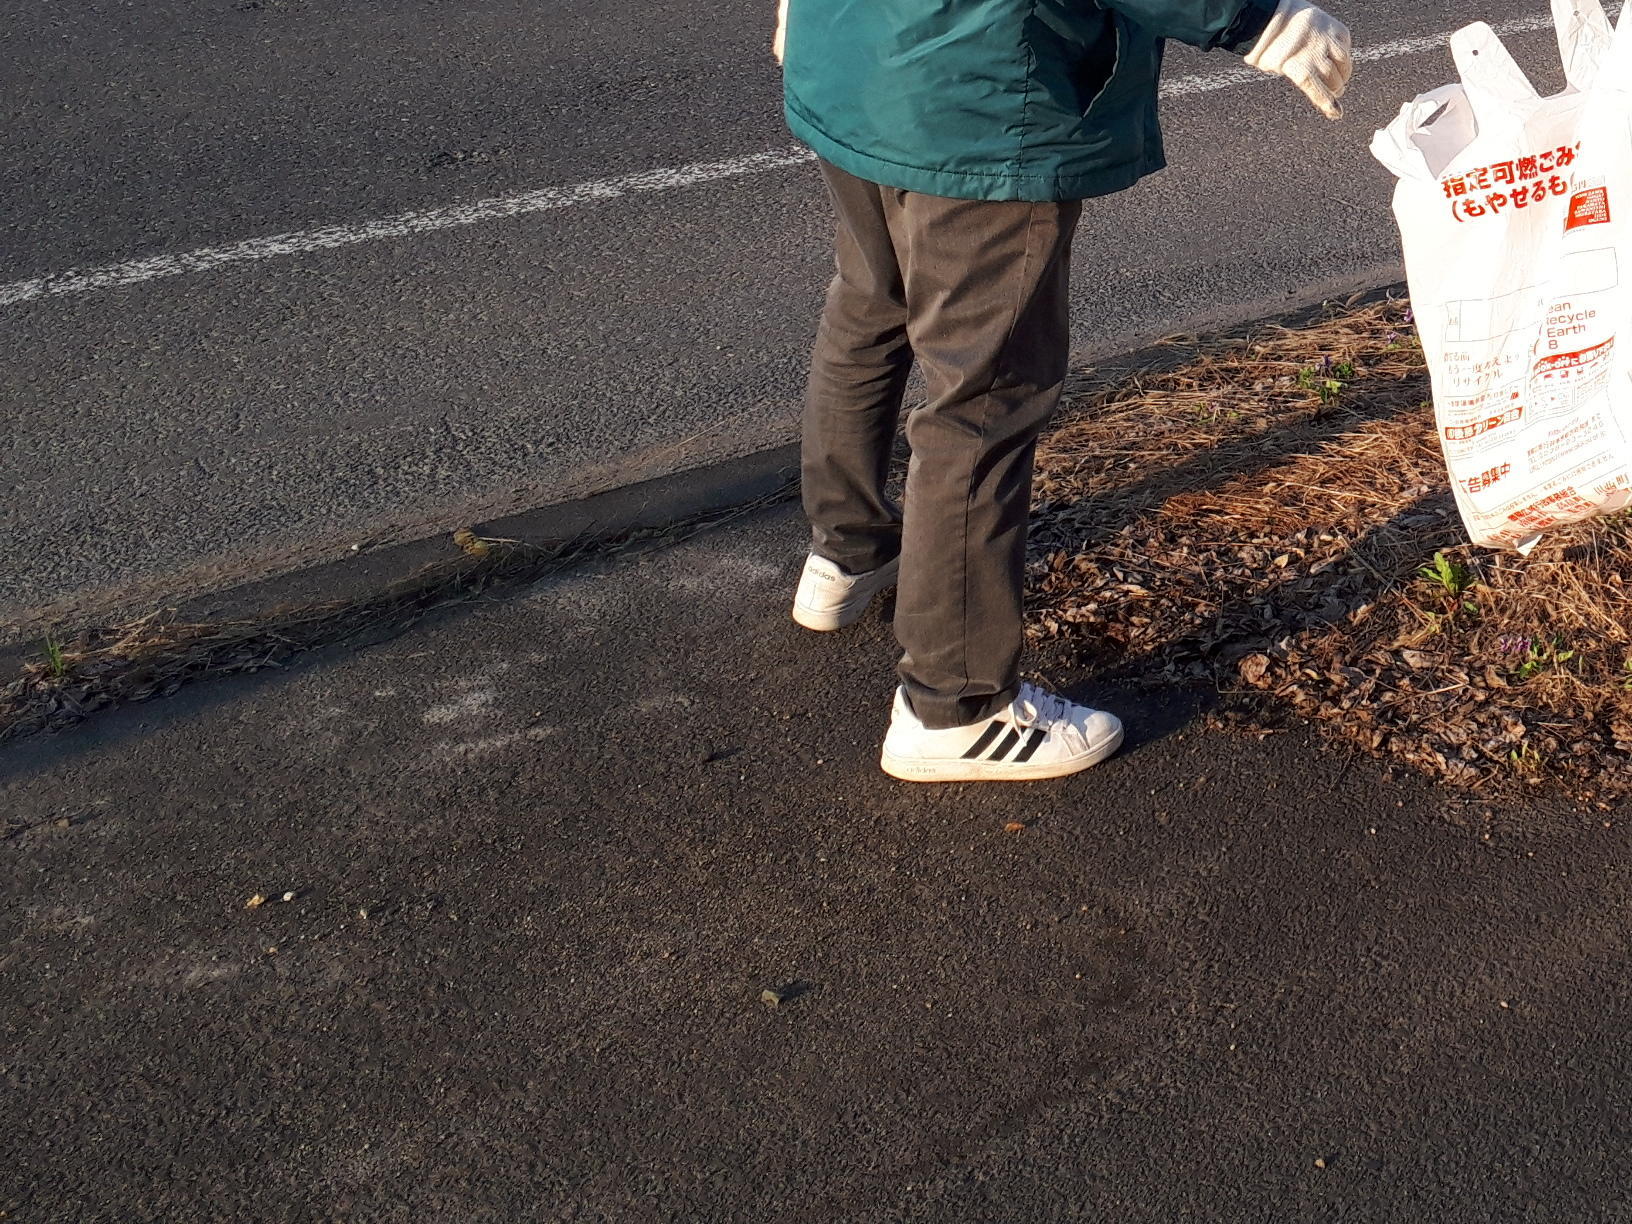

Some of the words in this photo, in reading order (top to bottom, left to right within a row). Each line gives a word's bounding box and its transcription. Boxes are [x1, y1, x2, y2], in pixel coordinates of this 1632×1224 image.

[1441, 141, 1580, 198] 指定可燃ごみ
[1547, 323, 1587, 338] Earth
